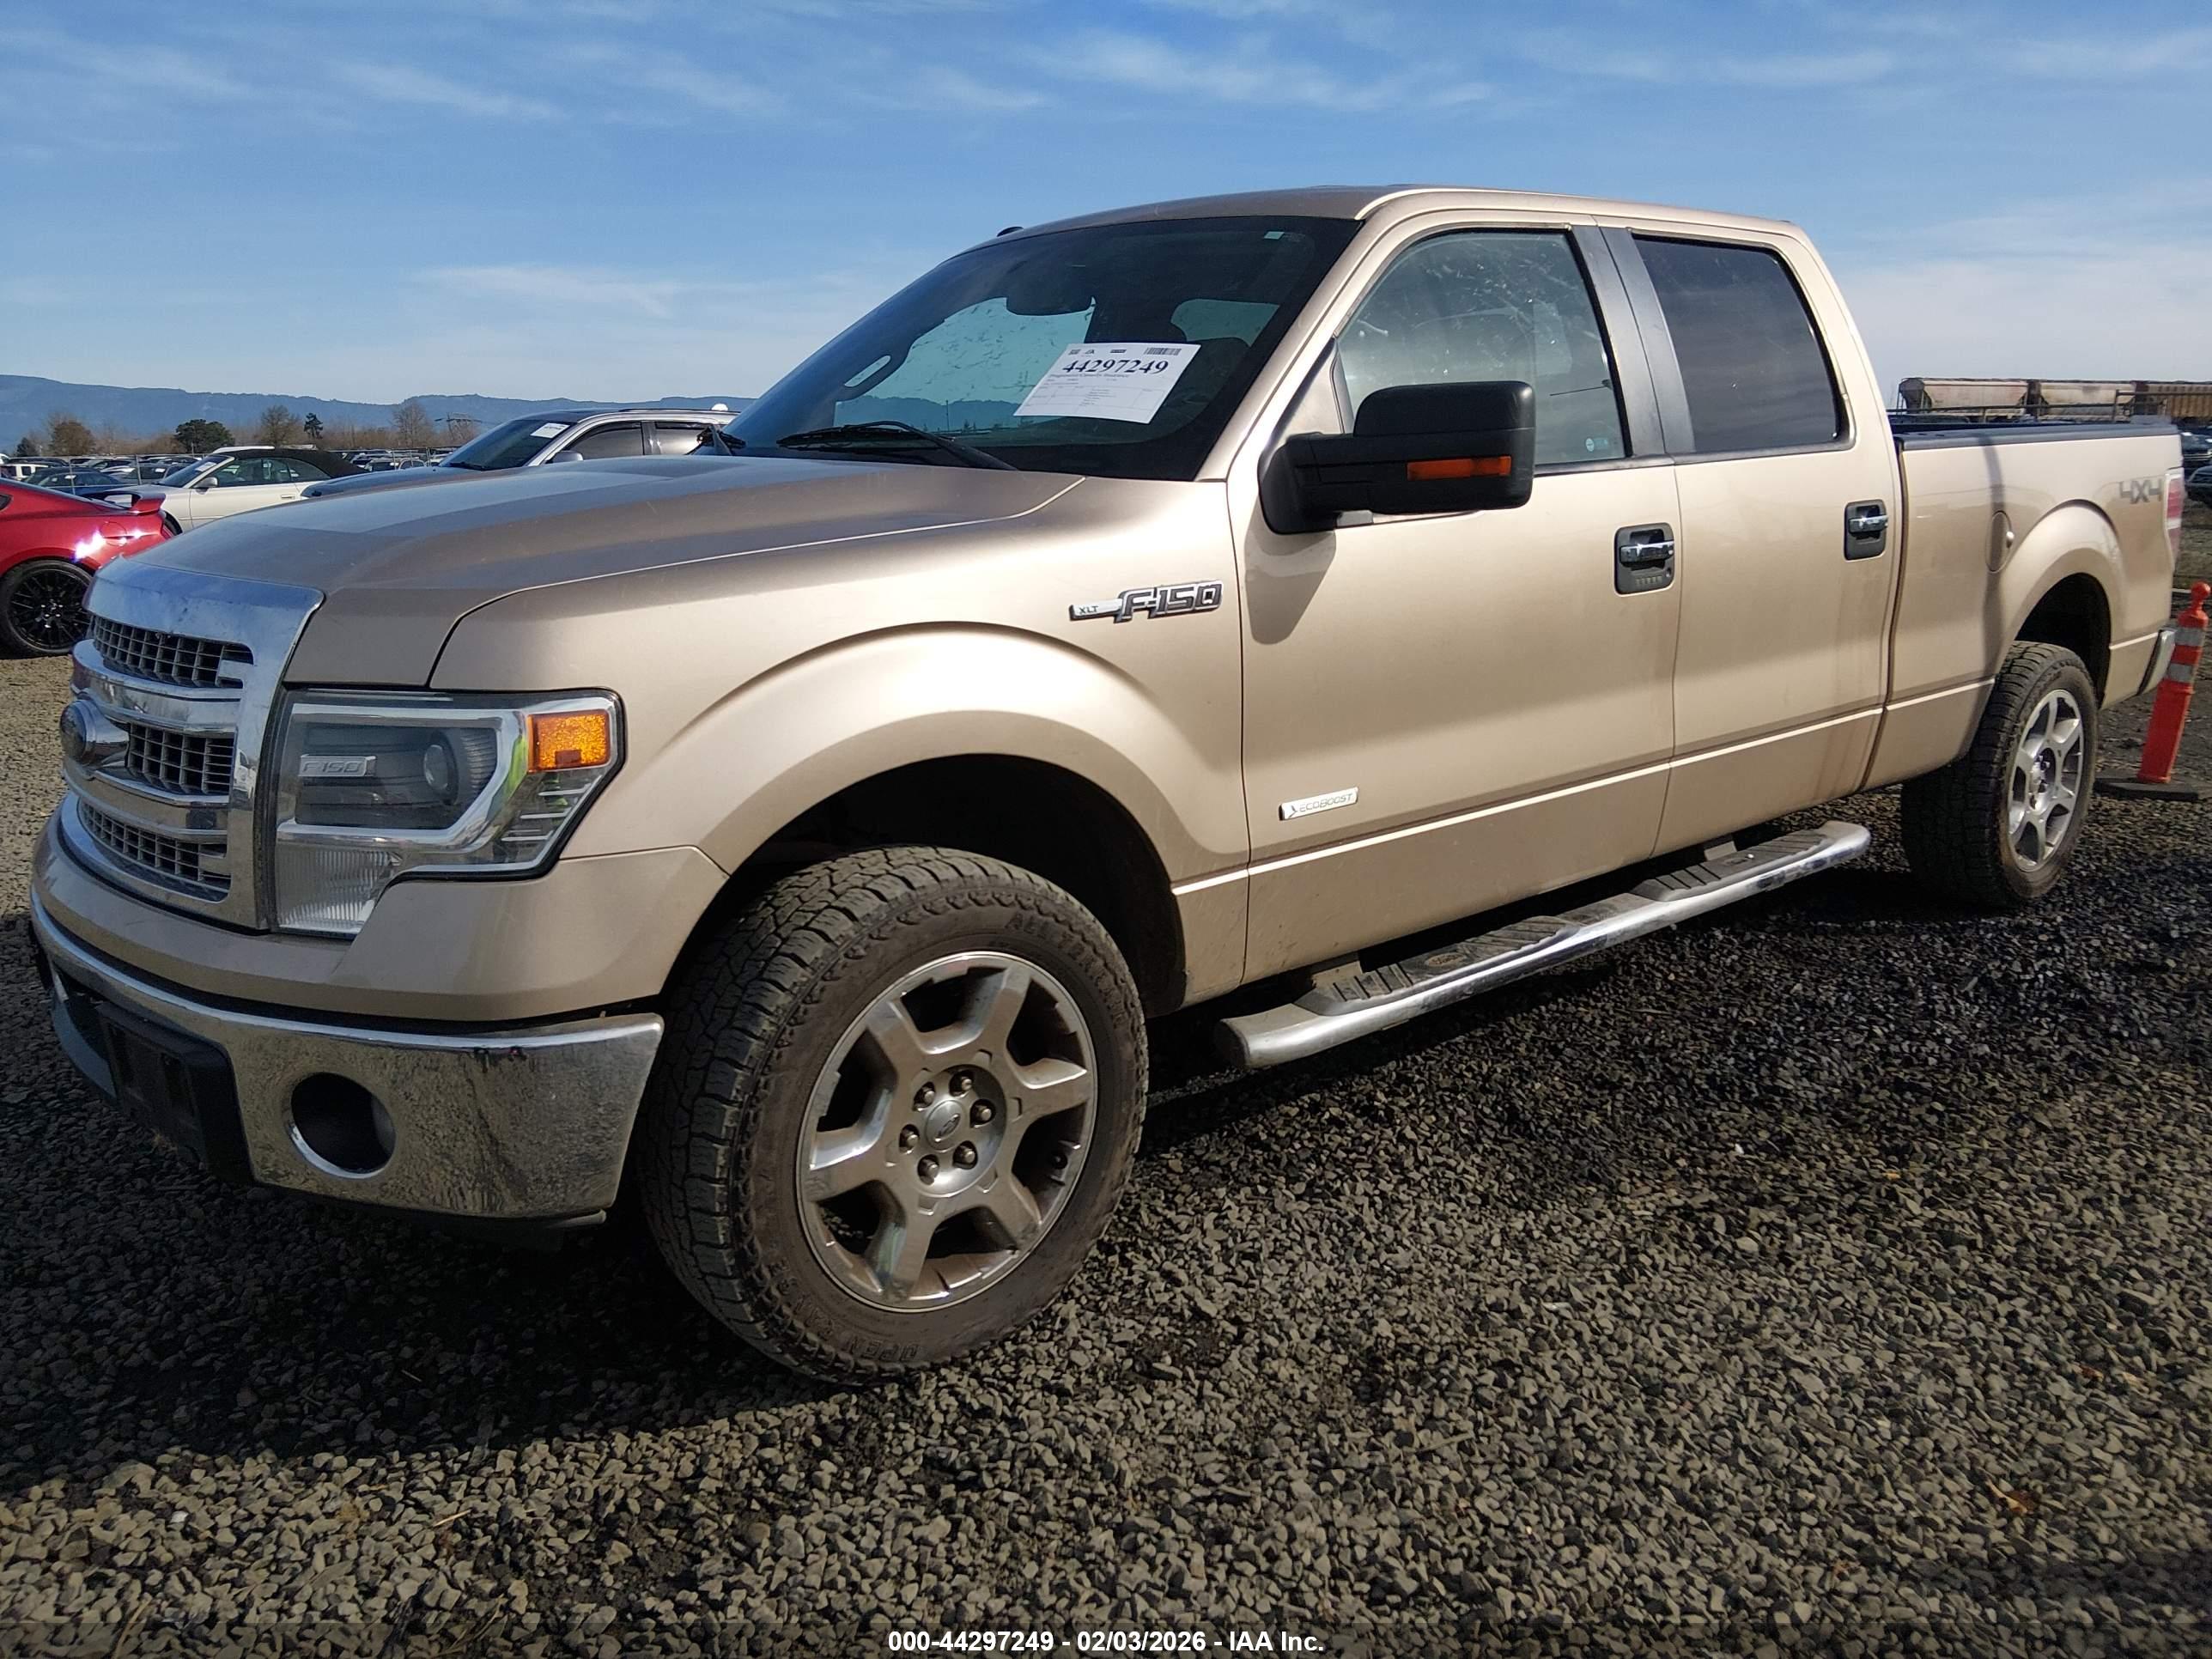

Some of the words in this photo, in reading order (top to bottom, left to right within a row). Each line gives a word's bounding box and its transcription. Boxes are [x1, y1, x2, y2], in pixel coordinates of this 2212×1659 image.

[1062, 360, 1169, 374] 44297249
[1078, 605, 1099, 615] XLT
[1114, 580, 1224, 623] F-150
